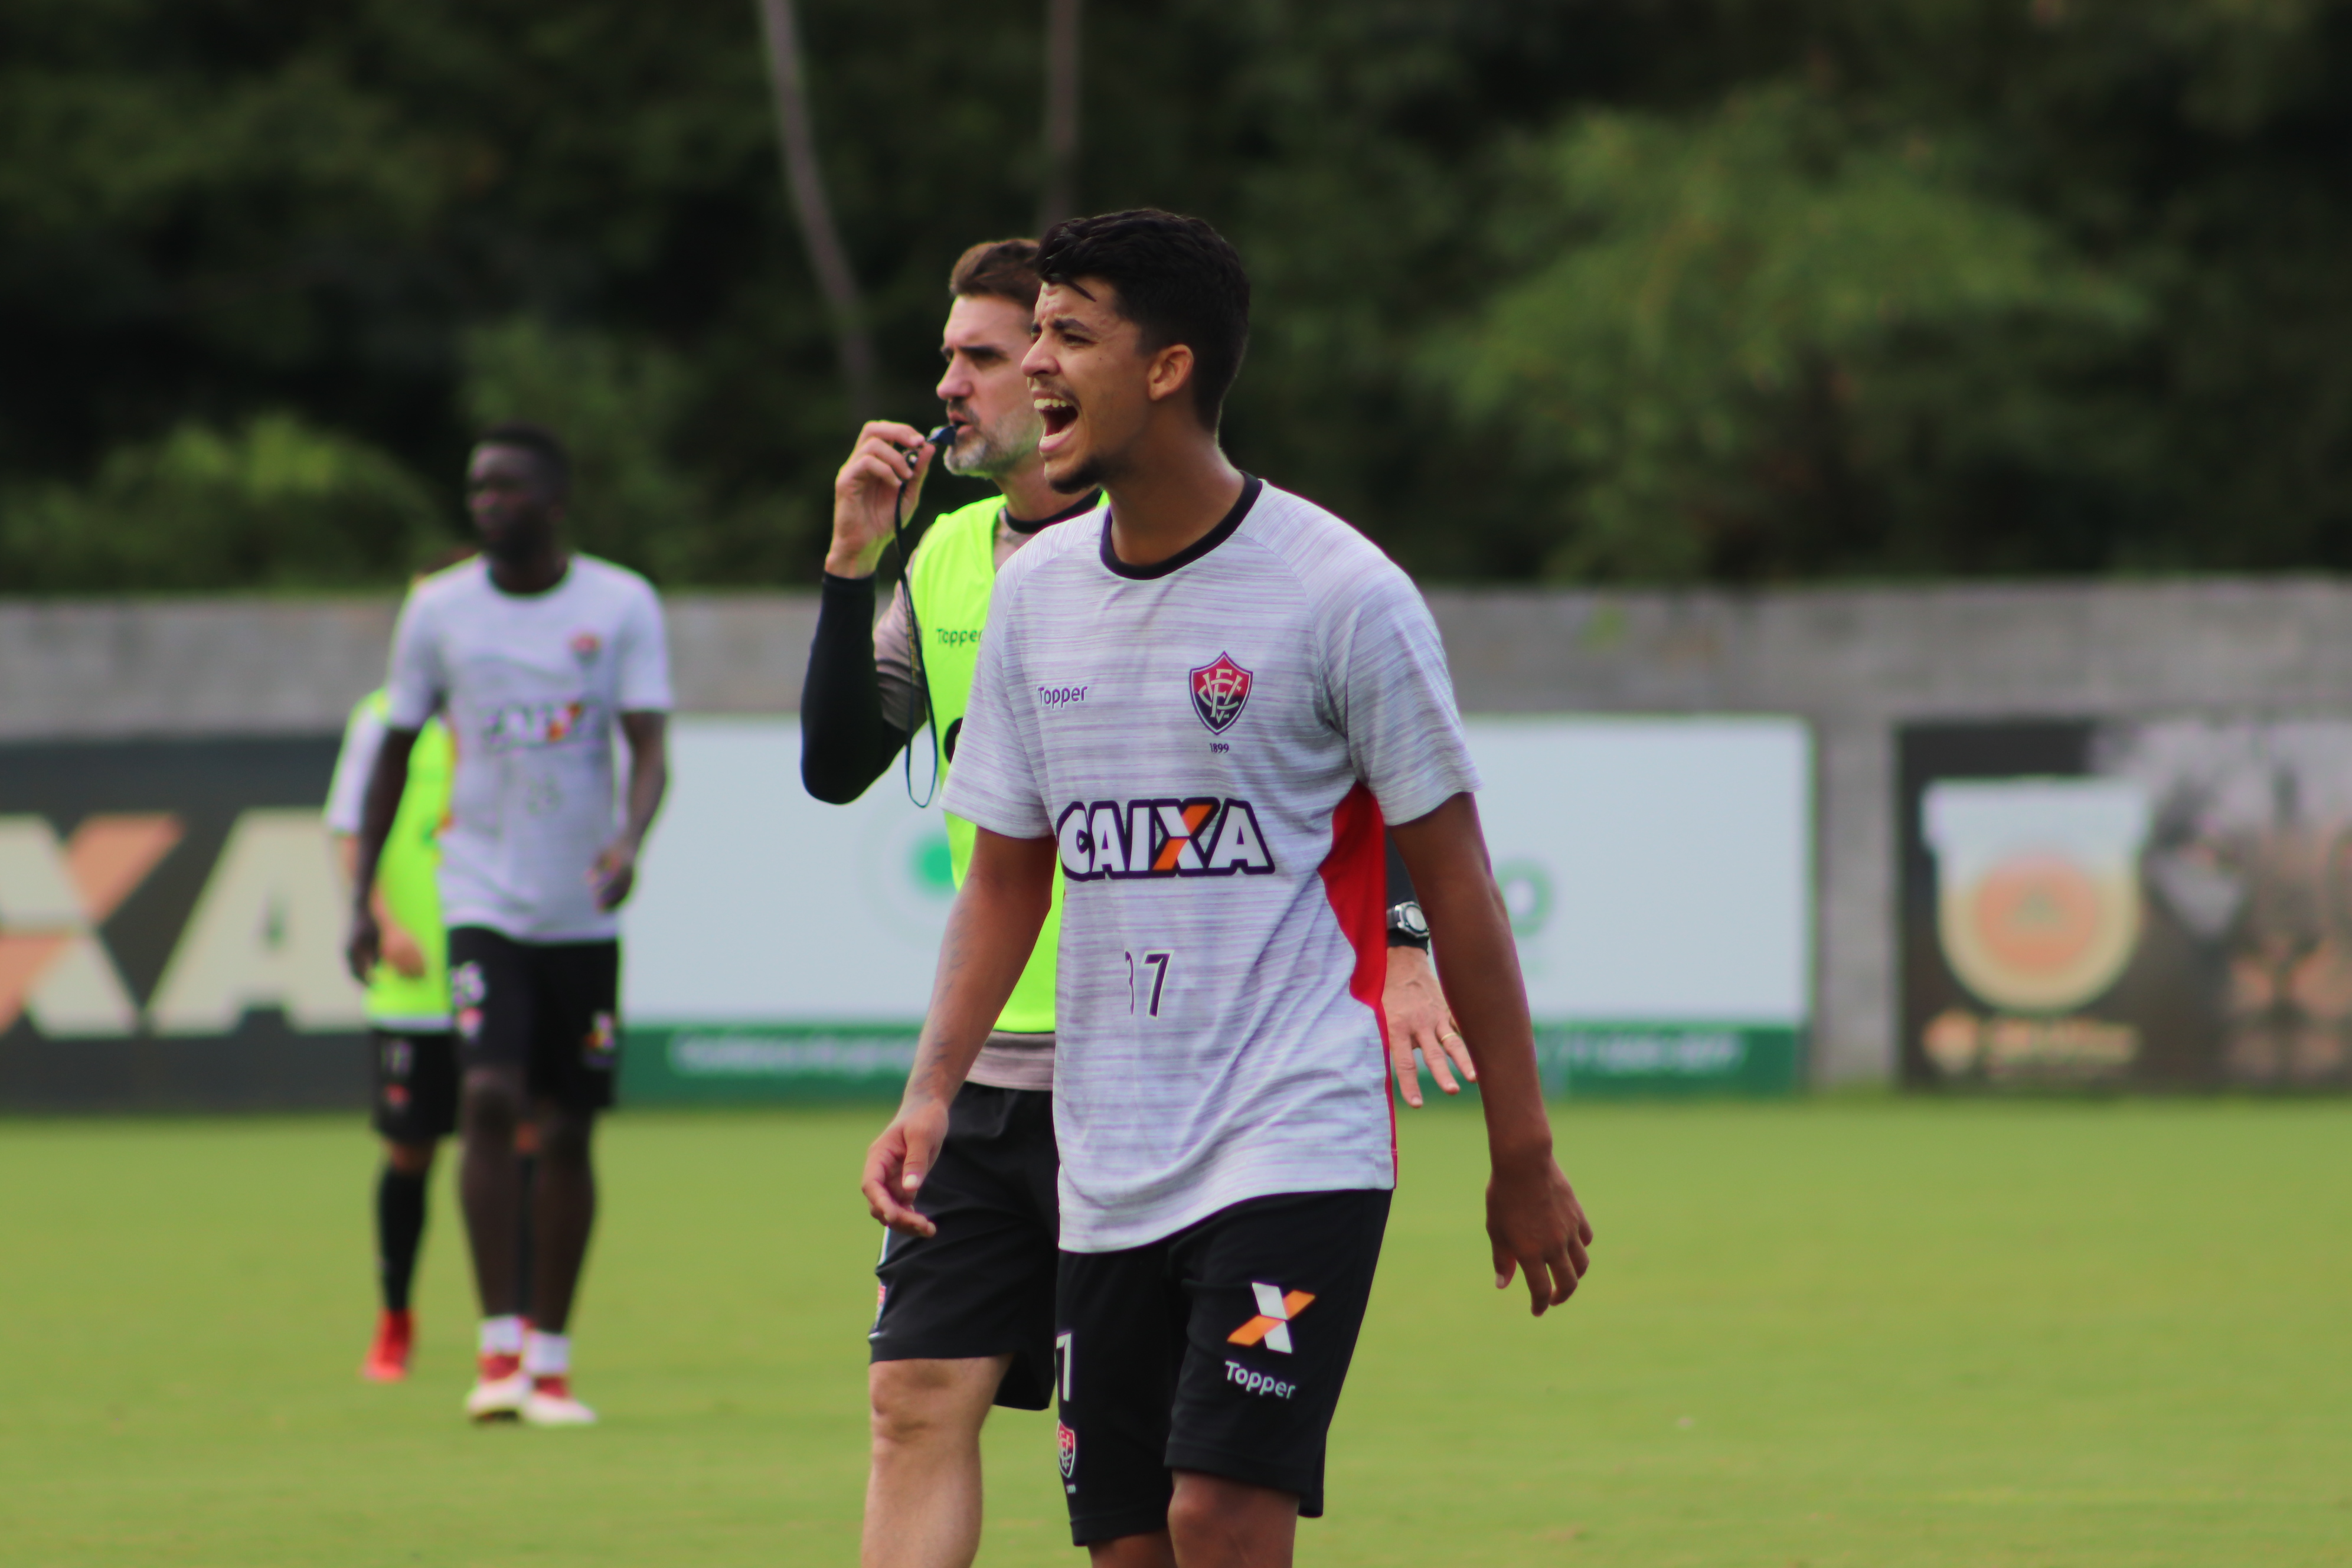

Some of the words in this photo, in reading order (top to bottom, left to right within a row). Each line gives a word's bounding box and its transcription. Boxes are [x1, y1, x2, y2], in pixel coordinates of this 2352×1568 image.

[1037, 686, 1088, 709] Topper
[1210, 742, 1230, 754] 1899
[1057, 797, 1275, 881] CAIXA
[1225, 1360, 1296, 1399] Topper
